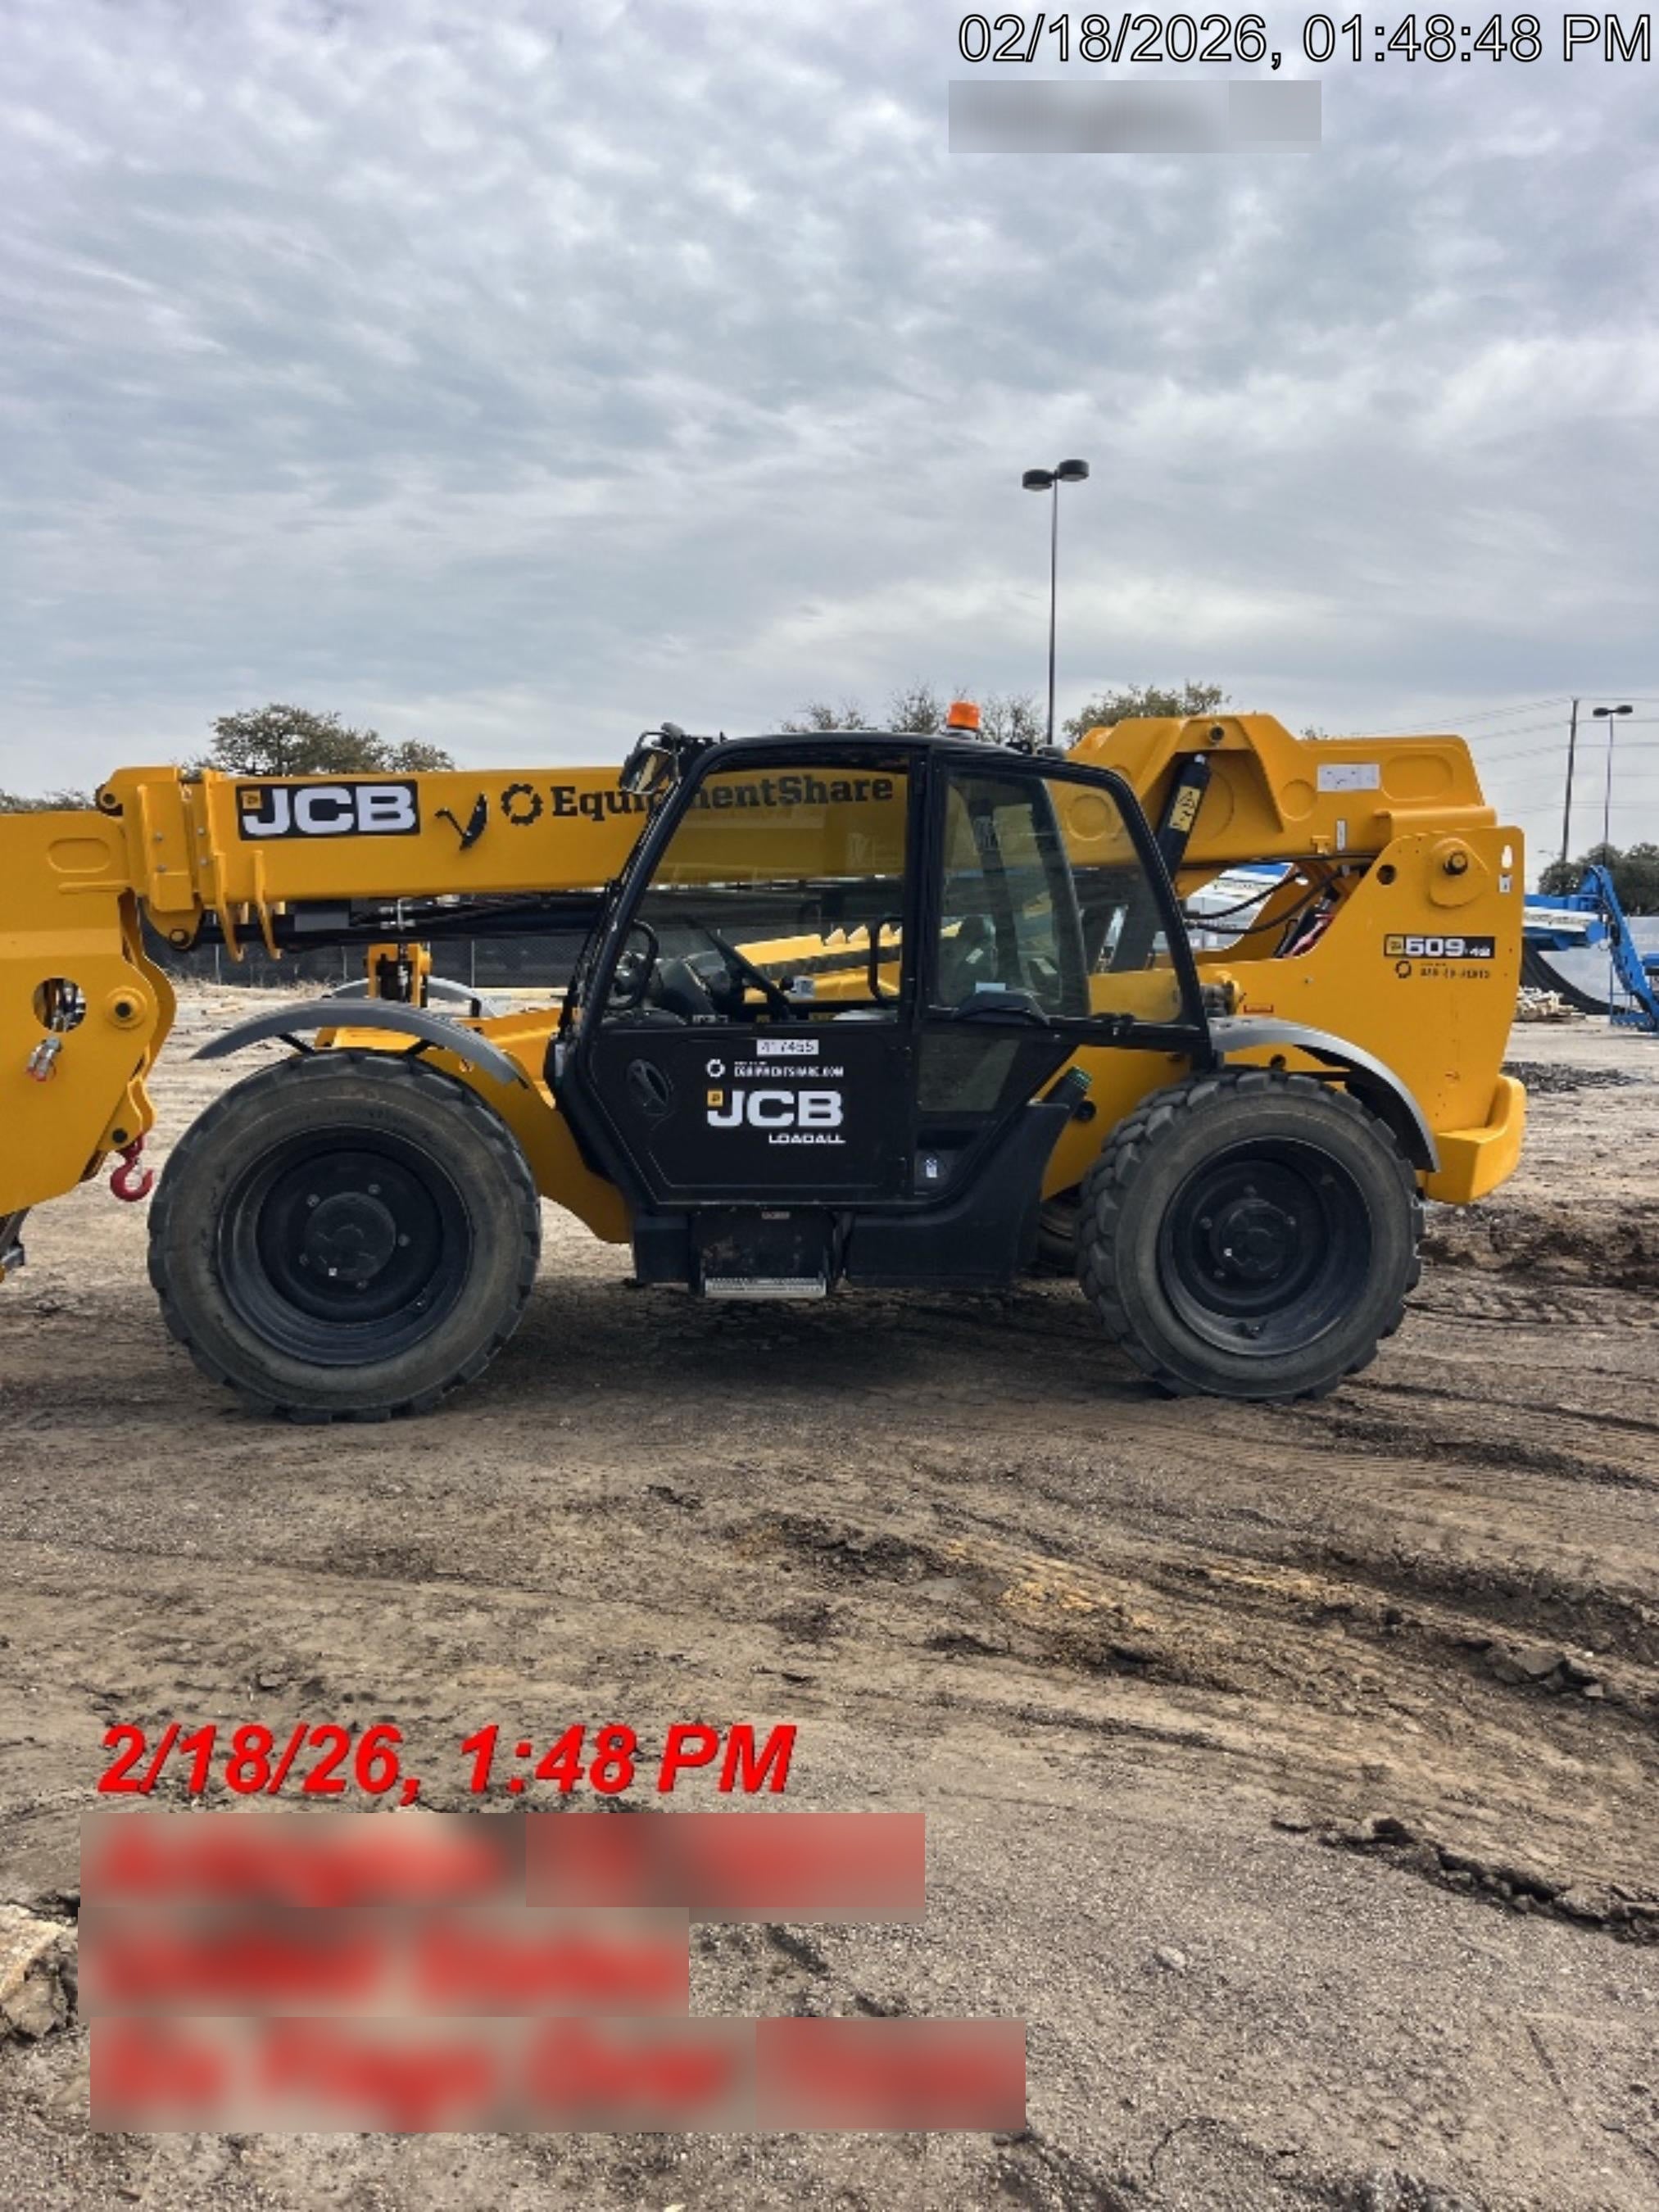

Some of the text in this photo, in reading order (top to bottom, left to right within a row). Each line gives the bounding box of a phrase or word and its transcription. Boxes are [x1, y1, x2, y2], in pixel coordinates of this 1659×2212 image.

[243, 786, 416, 836] JCB
[707, 1090, 844, 1126] JCB
[768, 1133, 846, 1145] LOADALL
